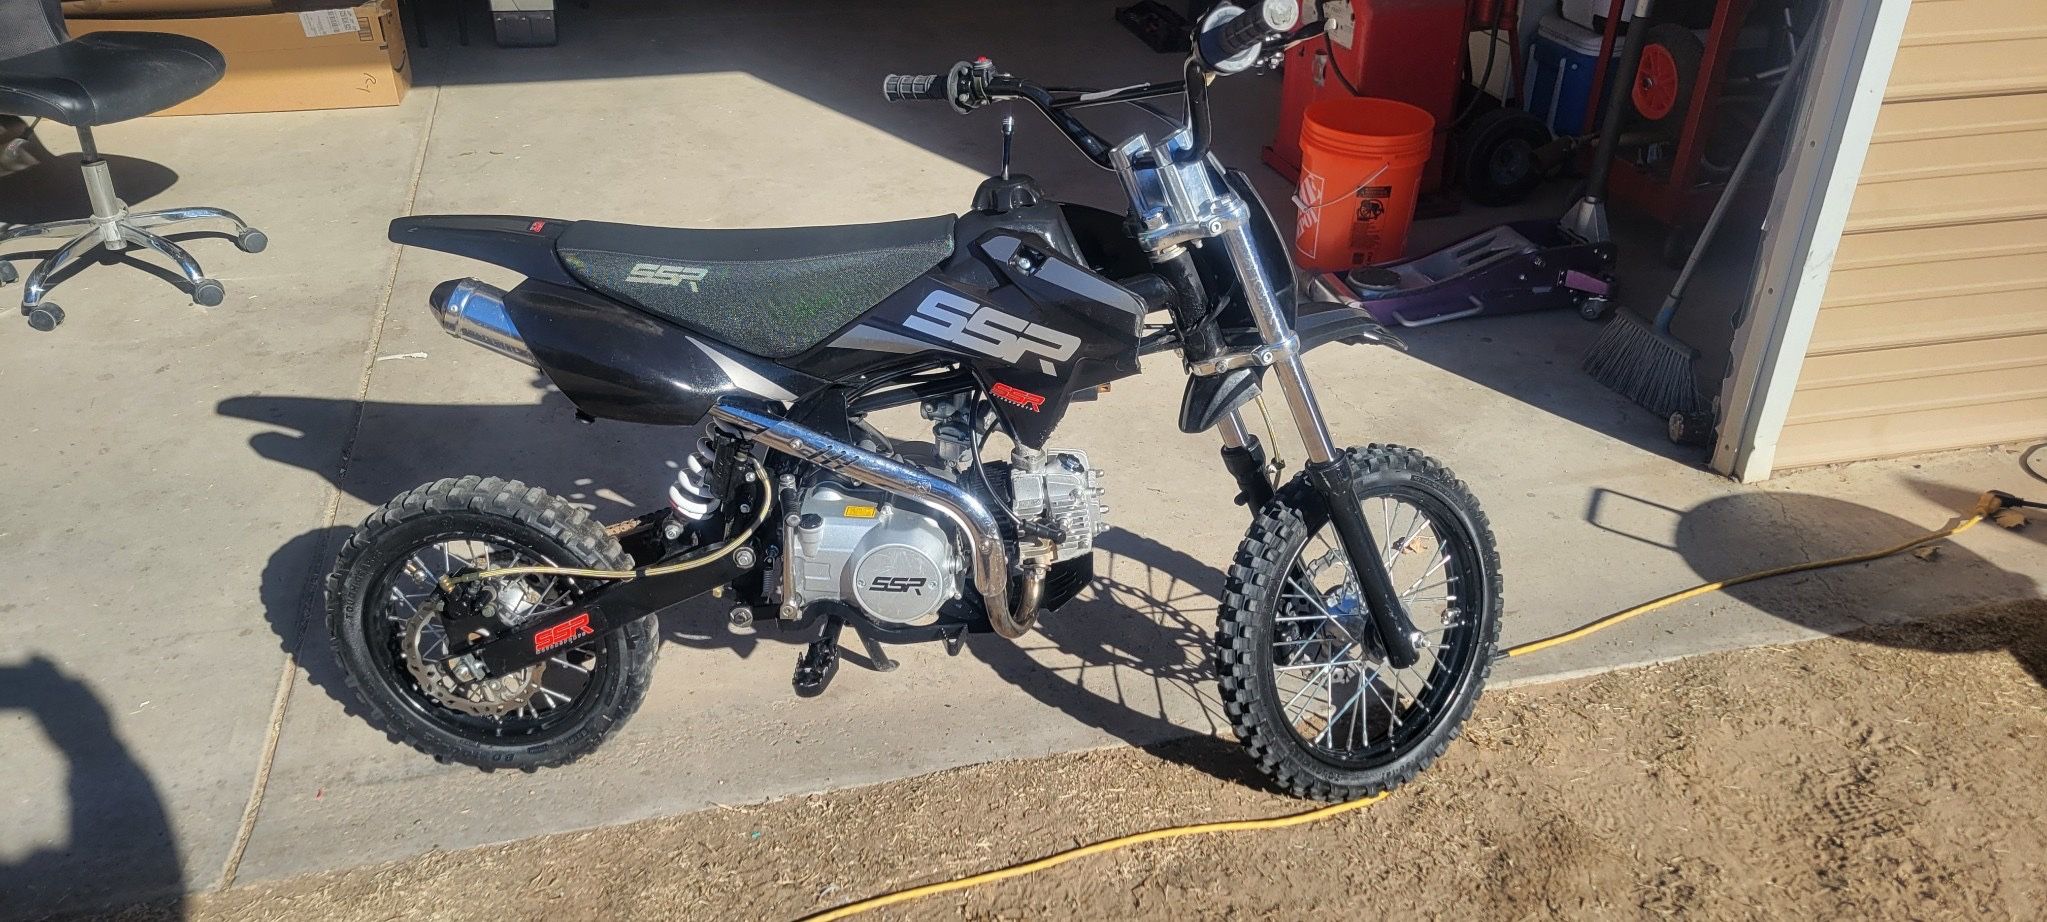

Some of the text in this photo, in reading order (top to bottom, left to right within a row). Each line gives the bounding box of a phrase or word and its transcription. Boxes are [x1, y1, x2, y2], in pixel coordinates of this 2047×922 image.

[625, 263, 708, 293] SSR
[902, 289, 1081, 377] SSR
[989, 382, 1046, 413] SSR
[869, 576, 927, 596] SSR
[535, 613, 594, 651] SSR
